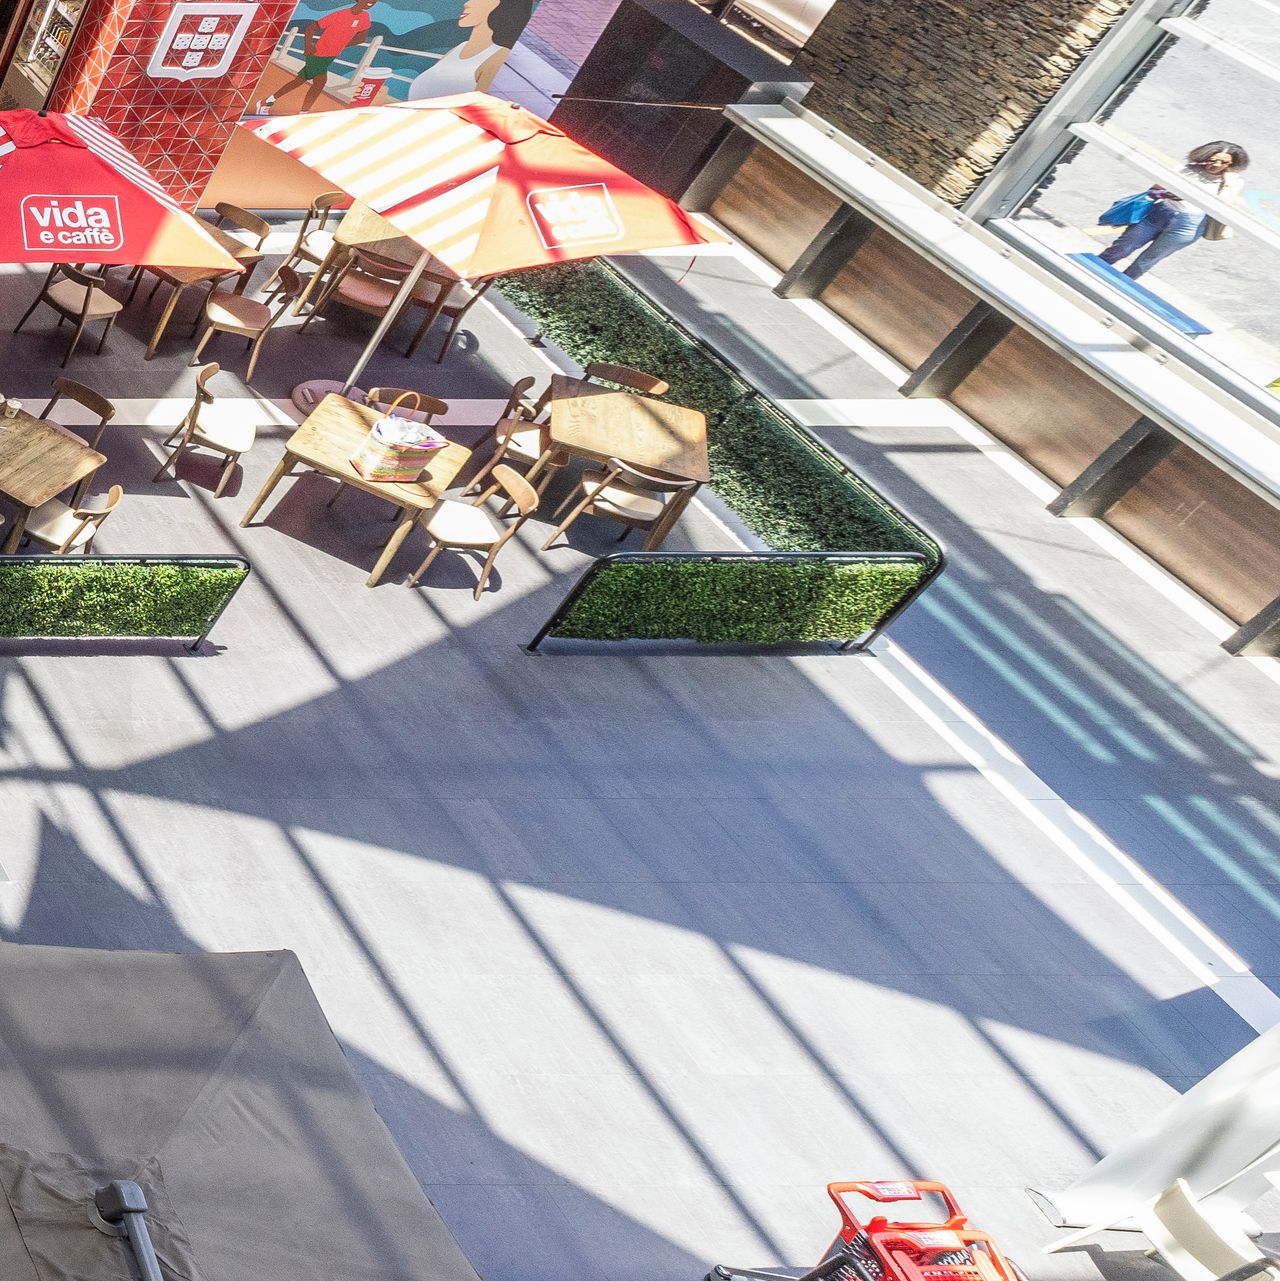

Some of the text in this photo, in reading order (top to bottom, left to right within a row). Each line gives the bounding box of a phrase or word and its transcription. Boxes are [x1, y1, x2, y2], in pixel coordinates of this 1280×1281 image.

[29, 200, 111, 230] vida
[39, 227, 115, 245] e caffè
